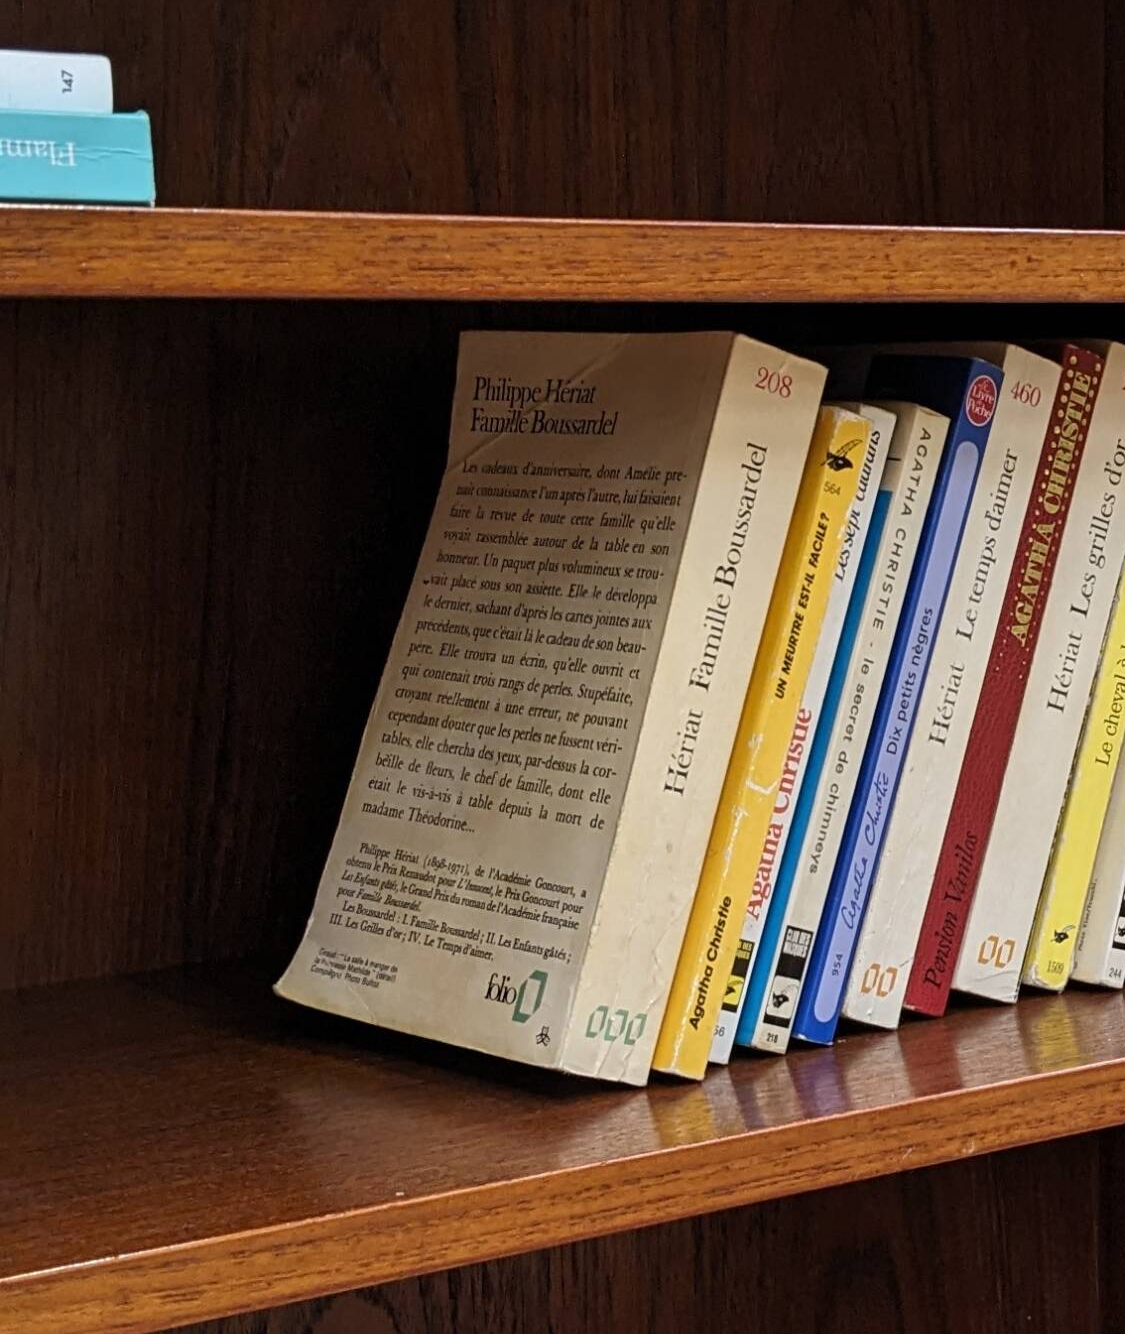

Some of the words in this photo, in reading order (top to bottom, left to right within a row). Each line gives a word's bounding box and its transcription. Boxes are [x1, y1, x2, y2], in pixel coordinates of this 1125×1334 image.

[61, 69, 74, 94] 147
[0, 138, 77, 166] Flam
[472, 376, 541, 409] Philippe
[544, 378, 597, 404] Hériat
[755, 366, 793, 398] 208
[1010, 380, 1041, 408] 460
[470, 406, 528, 434] Famille
[530, 409, 619, 436] Boussardel
[823, 482, 841, 496] 564
[901, 427, 932, 517] AGATHA
[1010, 522, 1057, 647] AGATHA
[1043, 371, 1091, 515] CHRISTIE
[872, 528, 907, 630] CHRISTIE
[928, 661, 966, 748] Hériat
[956, 607, 978, 642] Le
[968, 536, 997, 606] temps
[985, 447, 1019, 532] d'aimer
[664, 710, 704, 796] Hériat
[689, 593, 731, 692] Famille
[713, 442, 768, 589] Boussardel
[775, 678, 787, 700] UN
[784, 612, 804, 676] MEURTRE
[798, 571, 816, 609] EST-IL
[808, 512, 831, 568] FACILE?
[1046, 632, 1083, 714] Hériat
[1070, 572, 1097, 619] Les
[1088, 492, 1116, 569] grilles
[401, 665, 420, 680] qui
[422, 668, 471, 684] contenait
[472, 672, 495, 687] trois
[497, 677, 525, 695] rangs
[526, 677, 541, 693] de
[540, 681, 573, 699] perles.
[577, 683, 633, 706] Stupéfaite,
[861, 657, 875, 675] le
[394, 688, 433, 702] croyant
[436, 692, 490, 710] réellement
[504, 703, 525, 715] une
[528, 706, 561, 722] erreur,
[566, 711, 580, 723] ne
[581, 714, 629, 730] pouvant
[846, 683, 866, 742] secret
[387, 711, 440, 728] cependant
[440, 715, 476, 733] douter
[476, 724, 497, 740] que
[497, 722, 512, 739] les
[511, 726, 542, 745] perles
[543, 733, 557, 745] ne
[558, 730, 594, 750] fussent
[596, 738, 623, 754] véri-
[415, 735, 435, 751] elle
[436, 738, 476, 758] chercha
[477, 744, 494, 761] des
[495, 751, 522, 767] yeux,
[523, 755, 577, 773] par-dessus
[579, 759, 590, 775] la
[592, 766, 617, 779] cor-
[835, 750, 850, 774] de
[841, 857, 868, 930] Agatha
[864, 771, 889, 846] Christie
[887, 728, 902, 755] Dix
[897, 672, 916, 723] petits
[911, 607, 933, 667] nègres
[1095, 741, 1113, 767] Le
[361, 801, 405, 819] madame
[809, 782, 840, 874] chimneys
[359, 842, 391, 861] Philippe
[394, 849, 419, 864] Hériat
[474, 865, 485, 877] de
[580, 889, 587, 898] a
[923, 911, 958, 989] Pension
[944, 830, 978, 903] Vanilos
[689, 964, 714, 1031] Agatha
[706, 895, 732, 961] Christie
[832, 953, 844, 977] 954
[1108, 967, 1122, 979] 244
[484, 972, 517, 1005] folio
